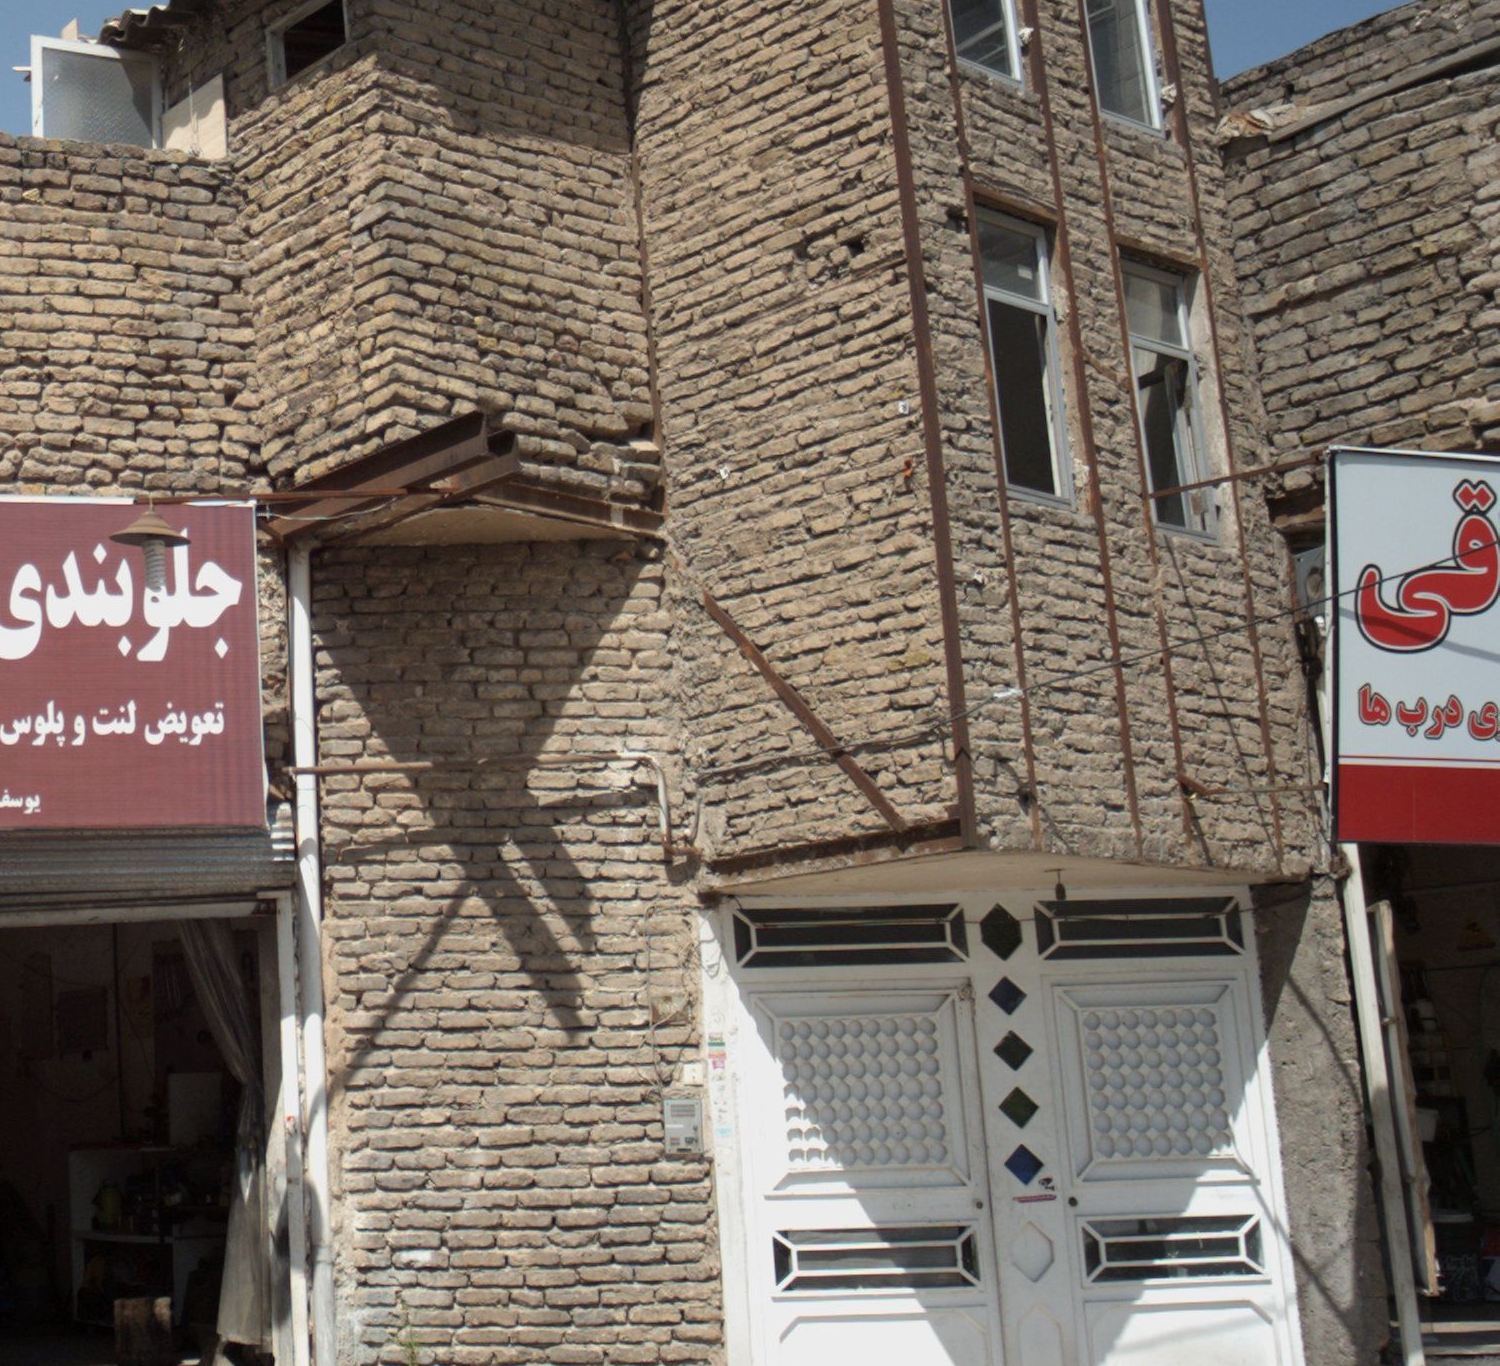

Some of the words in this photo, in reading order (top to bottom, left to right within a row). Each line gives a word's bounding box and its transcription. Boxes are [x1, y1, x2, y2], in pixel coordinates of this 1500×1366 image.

[71, 714, 86, 747] و
[91, 699, 137, 736] لنت
[143, 701, 225, 746] تعویض
[1395, 695, 1463, 740] درب
